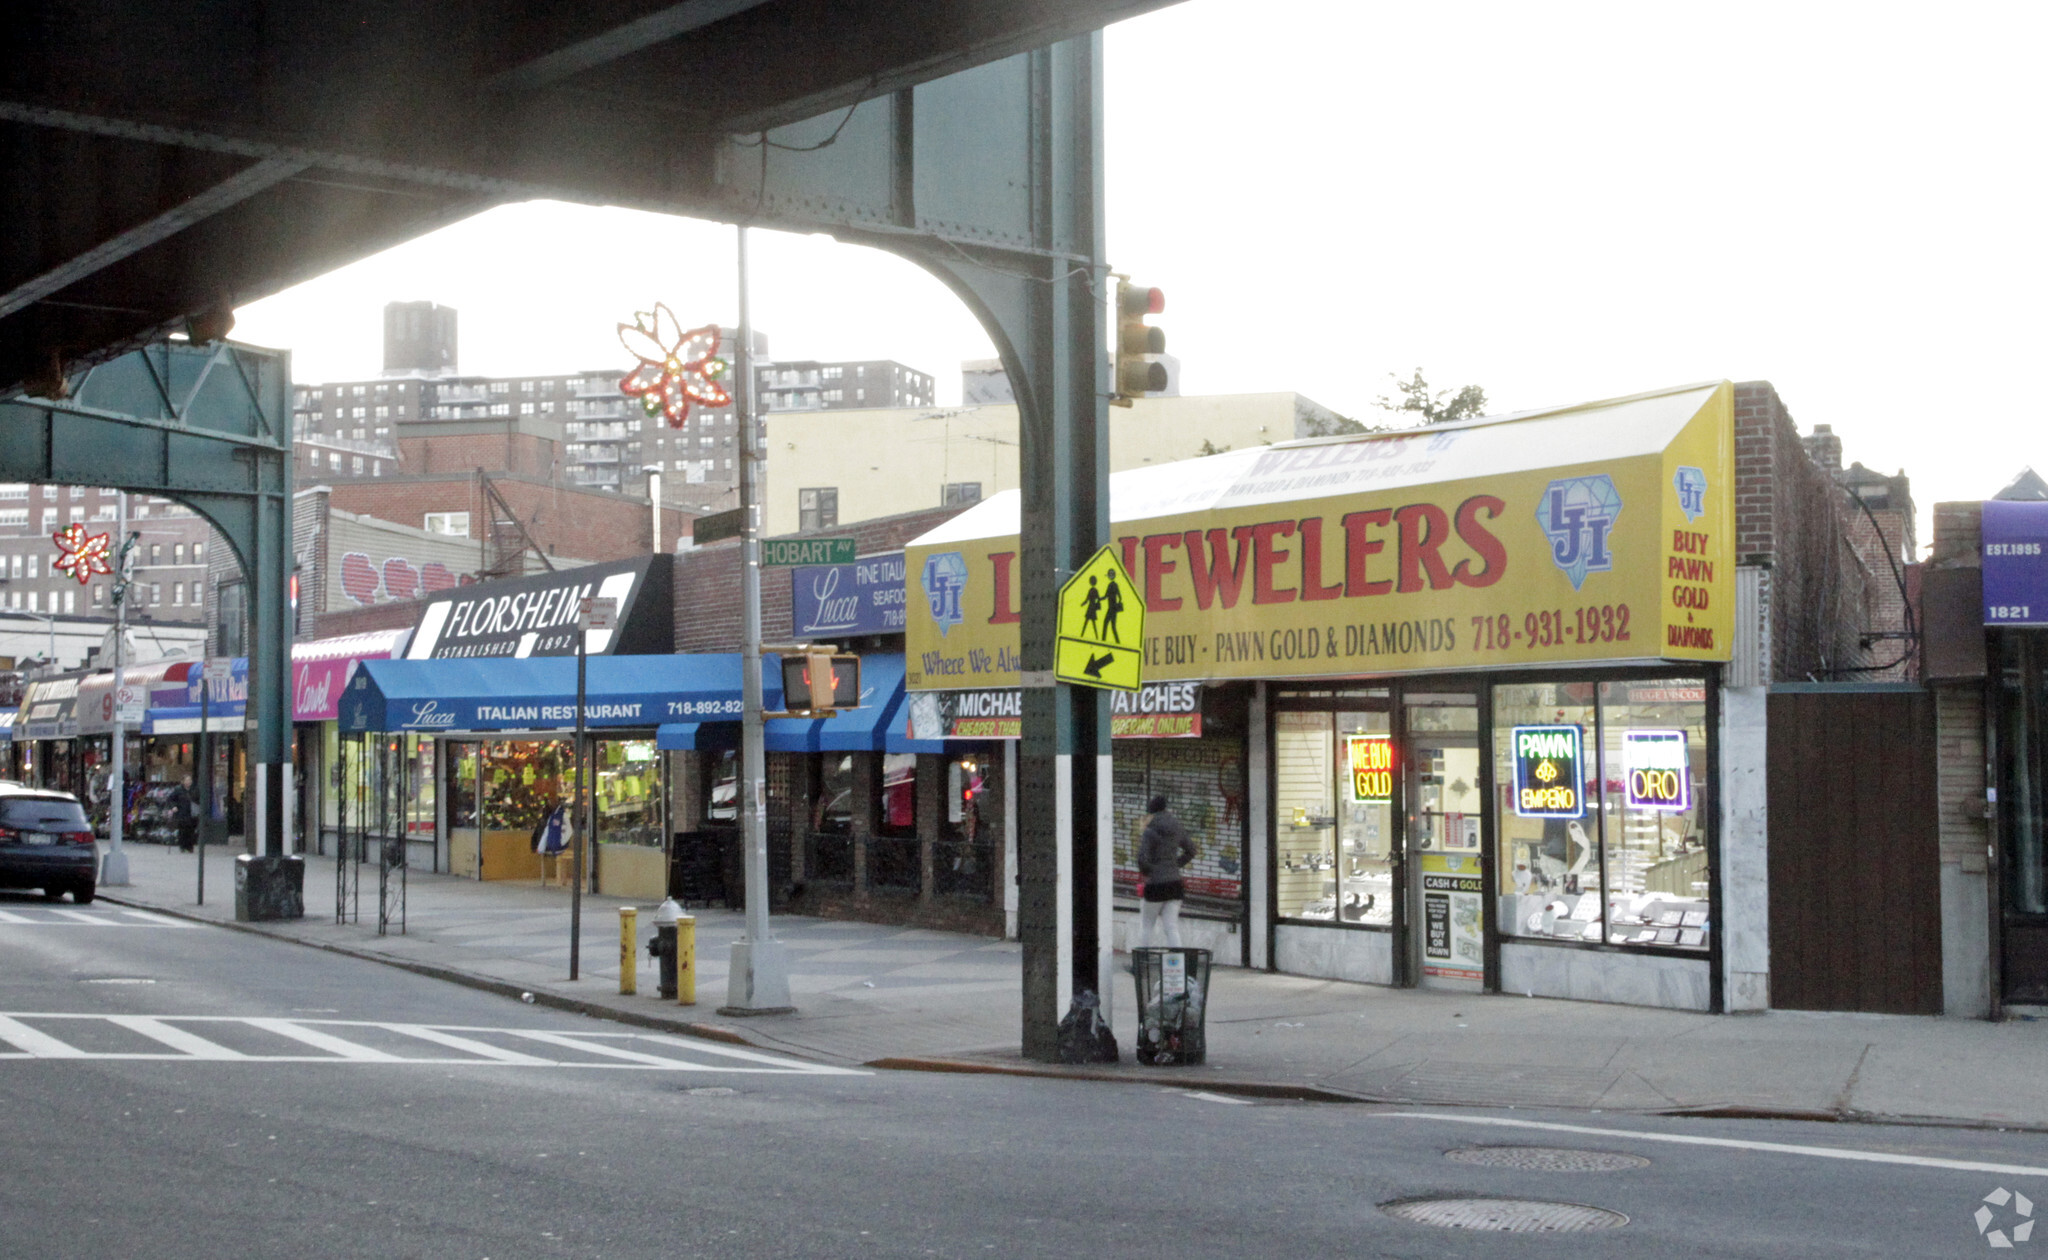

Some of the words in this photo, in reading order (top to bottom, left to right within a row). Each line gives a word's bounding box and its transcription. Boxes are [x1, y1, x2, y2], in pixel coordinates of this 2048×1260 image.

[764, 541, 833, 563] HOBART
[837, 541, 852, 552] AV
[1673, 529, 1709, 556] BUY
[856, 564, 879, 586] FINE
[1668, 556, 1714, 583] PAWN
[804, 567, 859, 632] Lucca
[873, 589, 907, 606] SEAFOO
[1672, 585, 1710, 611] GOLD
[445, 583, 592, 638] FLORSHEIM
[1989, 606, 2030, 618] 1821
[436, 640, 516, 659] ESTABLISHED
[537, 634, 572, 651] 1892
[922, 649, 966, 676] Where
[968, 647, 993, 674] We
[996, 645, 1022, 673] Alw
[1166, 634, 1198, 666] BUY
[1215, 631, 1265, 663] PAWN
[1270, 627, 1320, 661] GOLD
[1326, 626, 1338, 658] &
[1346, 617, 1456, 656] DIAMONDS
[1471, 603, 1631, 652] 718-931-1932
[1667, 624, 1714, 650] DIAMONDS
[959, 692, 1022, 717] MICHAE
[1664, 688, 1705, 700] DISCOU
[102, 692, 113, 722] 9
[402, 701, 457, 728] Lucca
[477, 705, 539, 721] ITALIAN
[541, 703, 643, 720] RESTAURANT
[957, 720, 997, 737] CHEAPER
[1112, 718, 1155, 735] RDERING
[1157, 716, 1194, 734] ONLINE
[1351, 742, 1370, 770] WE
[1370, 742, 1393, 770] BUY
[1518, 733, 1574, 759] PAWN
[1356, 771, 1393, 797] GOLD
[1631, 769, 1680, 801] ORO
[1520, 786, 1575, 810] EMPEÑO
[1425, 877, 1450, 889] CASH
[1451, 879, 1458, 890] 4
[1430, 930, 1445, 939] BUY
[1431, 921, 1444, 931] WE
[1427, 946, 1449, 957] PAWN
[1432, 938, 1444, 948] OR
